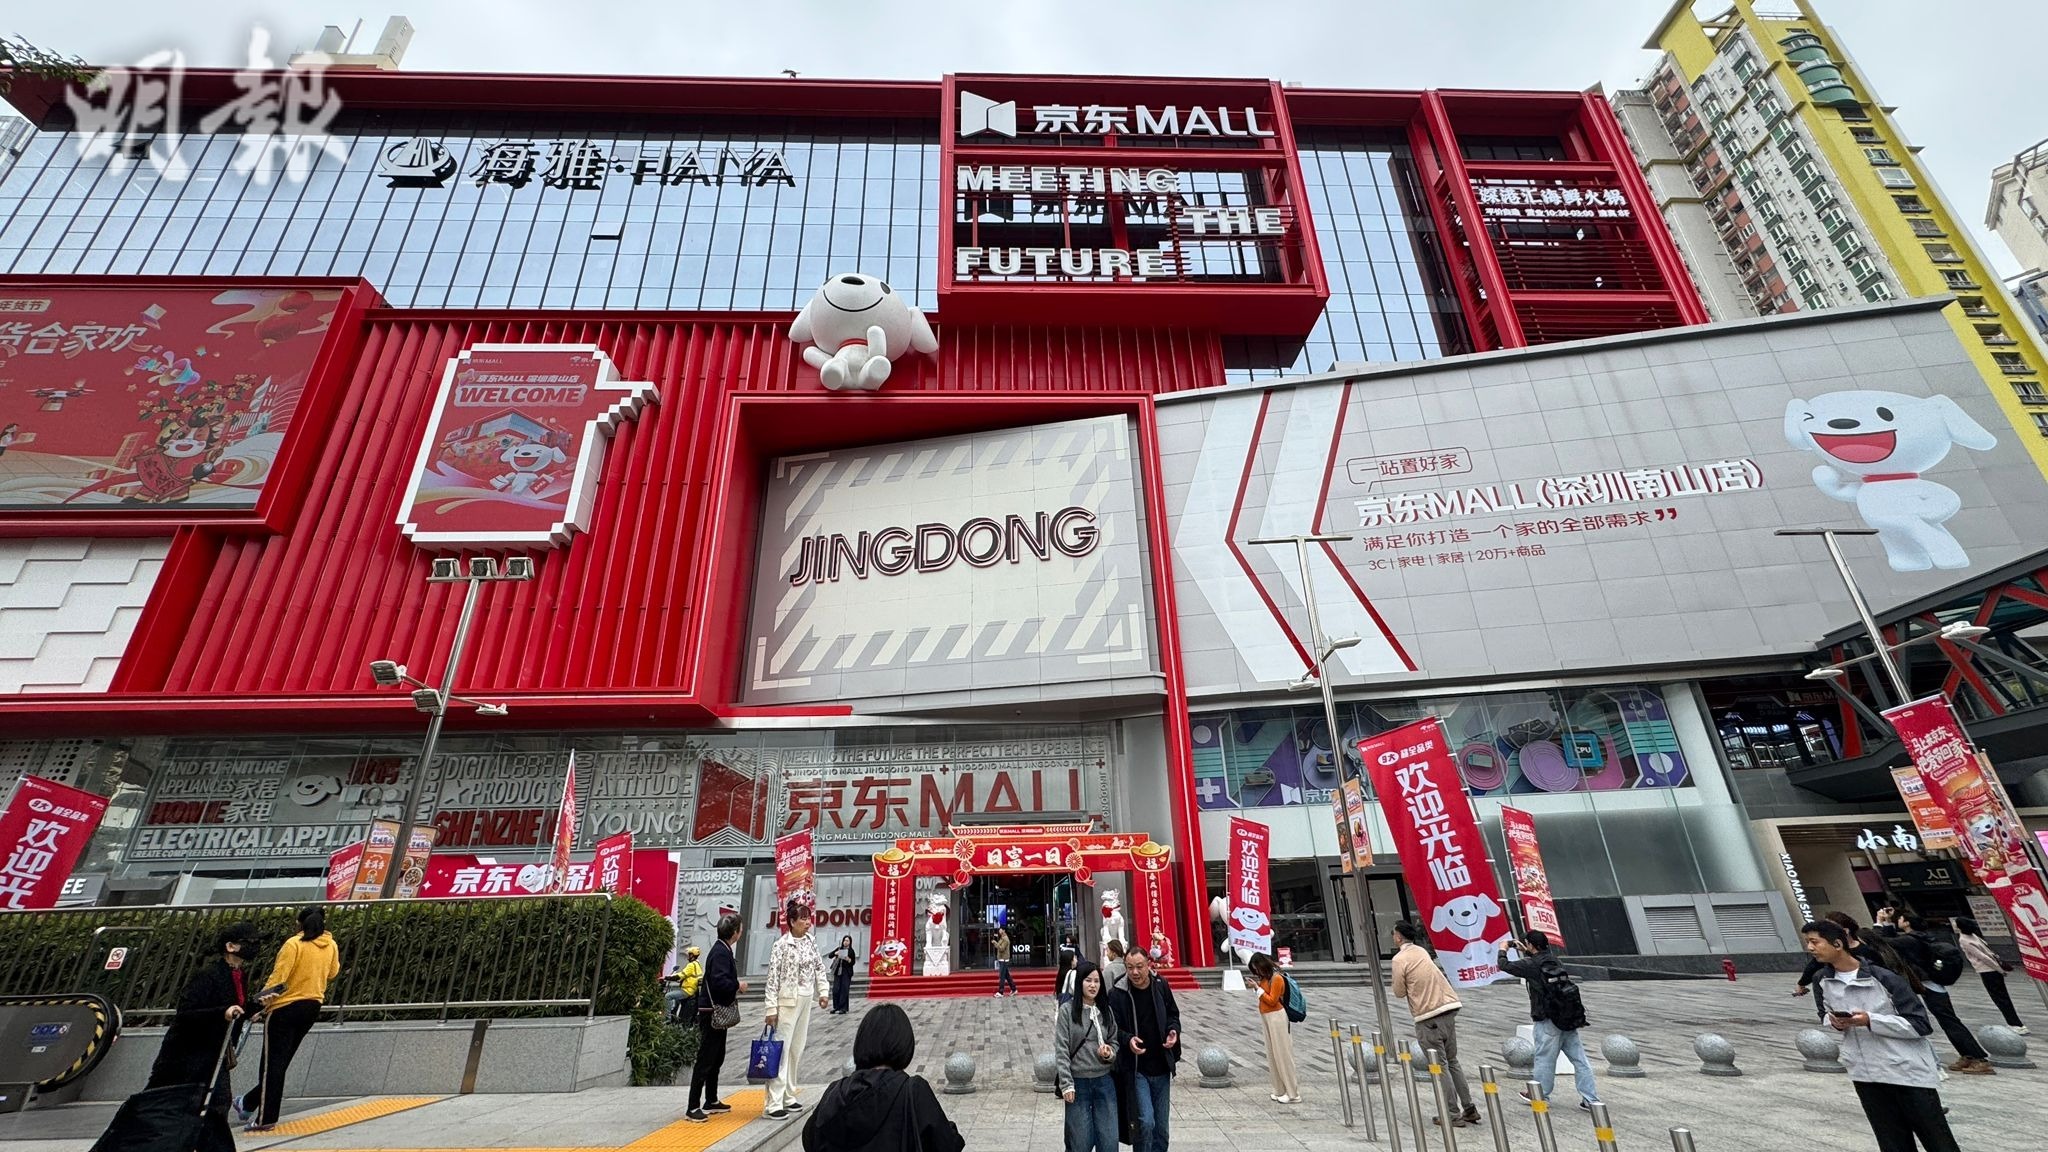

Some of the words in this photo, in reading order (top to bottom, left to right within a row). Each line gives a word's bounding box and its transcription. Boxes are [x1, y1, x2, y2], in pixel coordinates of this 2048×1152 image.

[1033, 103, 1275, 137] 京东MALL
[957, 165, 1179, 194] MEETING
[1183, 207, 1287, 235] THE
[956, 246, 1167, 277] FUTURE
[459, 387, 582, 403] WELCOME
[1360, 452, 1460, 476] 一站置好家
[789, 506, 1100, 587] JINGDONG
[782, 749, 838, 765] MEETING
[841, 749, 864, 763] THE
[865, 748, 913, 762] FUTURE
[915, 746, 940, 760] THE
[941, 744, 996, 759] PERFECT
[995, 743, 1029, 757] TECH
[1031, 740, 1105, 756] EXPERIENCE
[1575, 746, 1592, 754] CPU
[164, 760, 201, 776] AND
[200, 759, 289, 776] FURNITURE
[445, 755, 510, 780] DIGITAL
[599, 752, 669, 775] TREND
[839, 768, 863, 776] MALL
[864, 766, 911, 775] JINGDONG
[911, 765, 935, 773] MALL
[999, 762, 1023, 770] MALL
[157, 778, 238, 794] APPLIANCES
[231, 777, 281, 800] 家居
[468, 780, 566, 805] PRODUCTS
[593, 774, 693, 797] ATTITUDE
[784, 769, 1102, 830] 京东MALL
[146, 800, 232, 825] HOME
[224, 801, 273, 823] 家电
[589, 811, 686, 836] YOUNG
[135, 827, 275, 850] ELECTRICAL
[276, 824, 363, 848] APPLIA
[834, 832, 858, 840] MALL
[859, 831, 908, 840] JINGDONG
[908, 830, 933, 838] MALL
[1394, 762, 1473, 892] 欢迎光临
[1856, 825, 1918, 852] 小南
[888, 863, 900, 876] 福
[987, 845, 1062, 869] 日富一日
[1146, 857, 1158, 869] 福
[449, 866, 517, 894] 京东
[600, 853, 620, 894] 欢迎
[1241, 839, 1260, 906] 欢迎光临
[1779, 852, 1797, 880] XIAO
[1790, 878, 1807, 903] NAN
[1926, 867, 1950, 880] 入口
